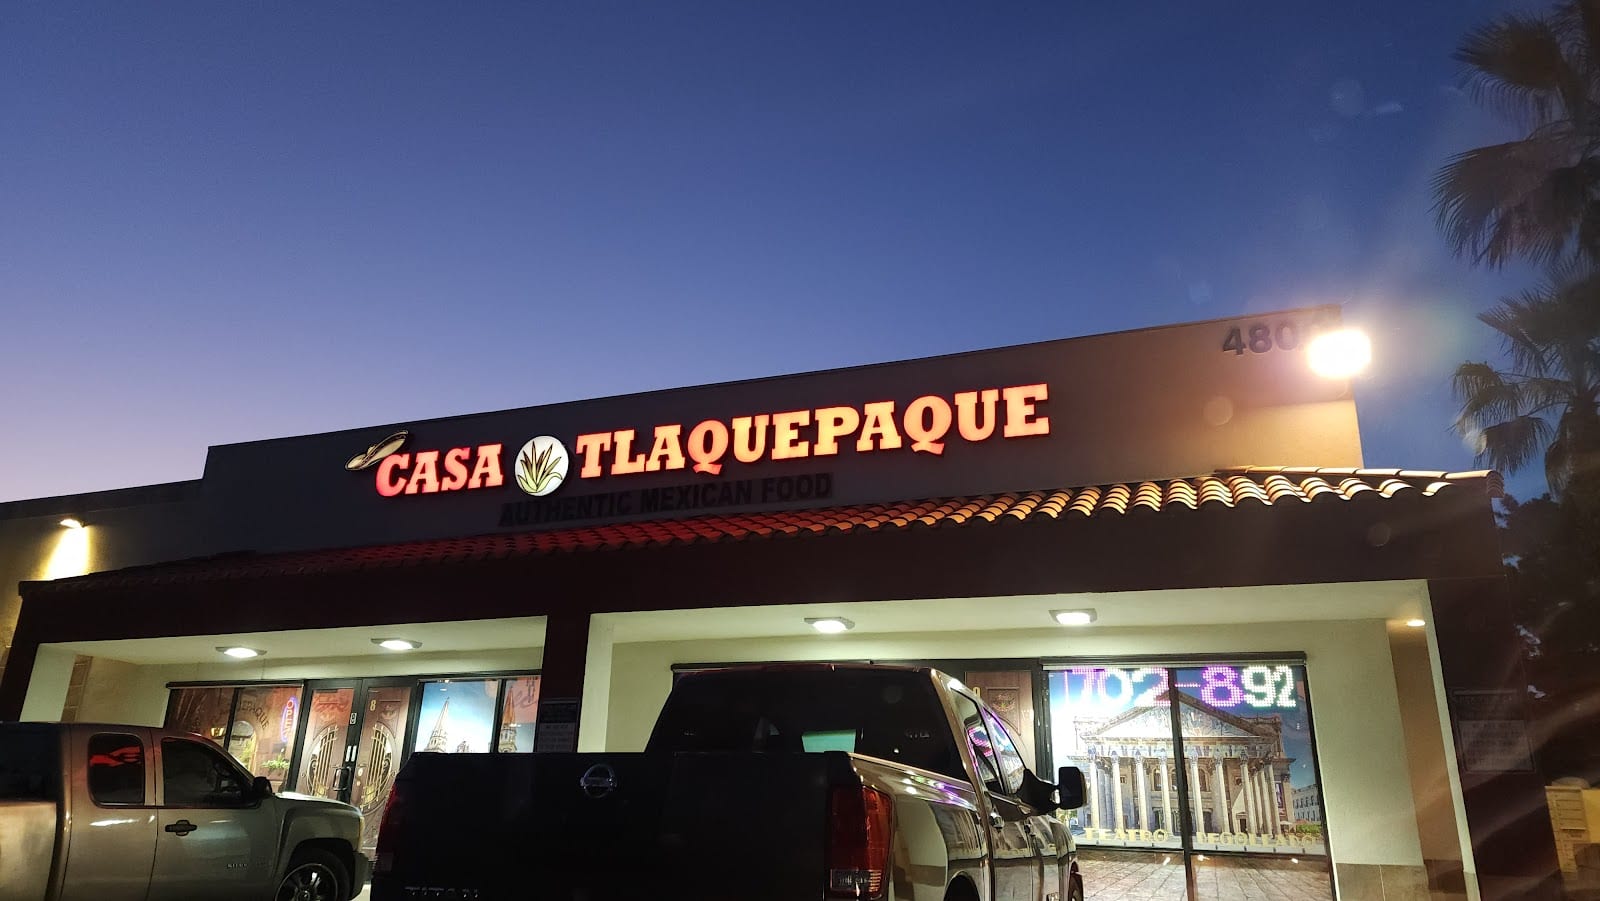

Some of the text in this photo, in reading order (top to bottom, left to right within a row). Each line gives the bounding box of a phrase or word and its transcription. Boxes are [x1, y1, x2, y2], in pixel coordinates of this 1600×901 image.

[375, 383, 1050, 497] CASA TLAQUEPAQUE
[499, 473, 833, 527] AUTHENTIC MEXICAN FOOD
[369, 699, 377, 711] 8
